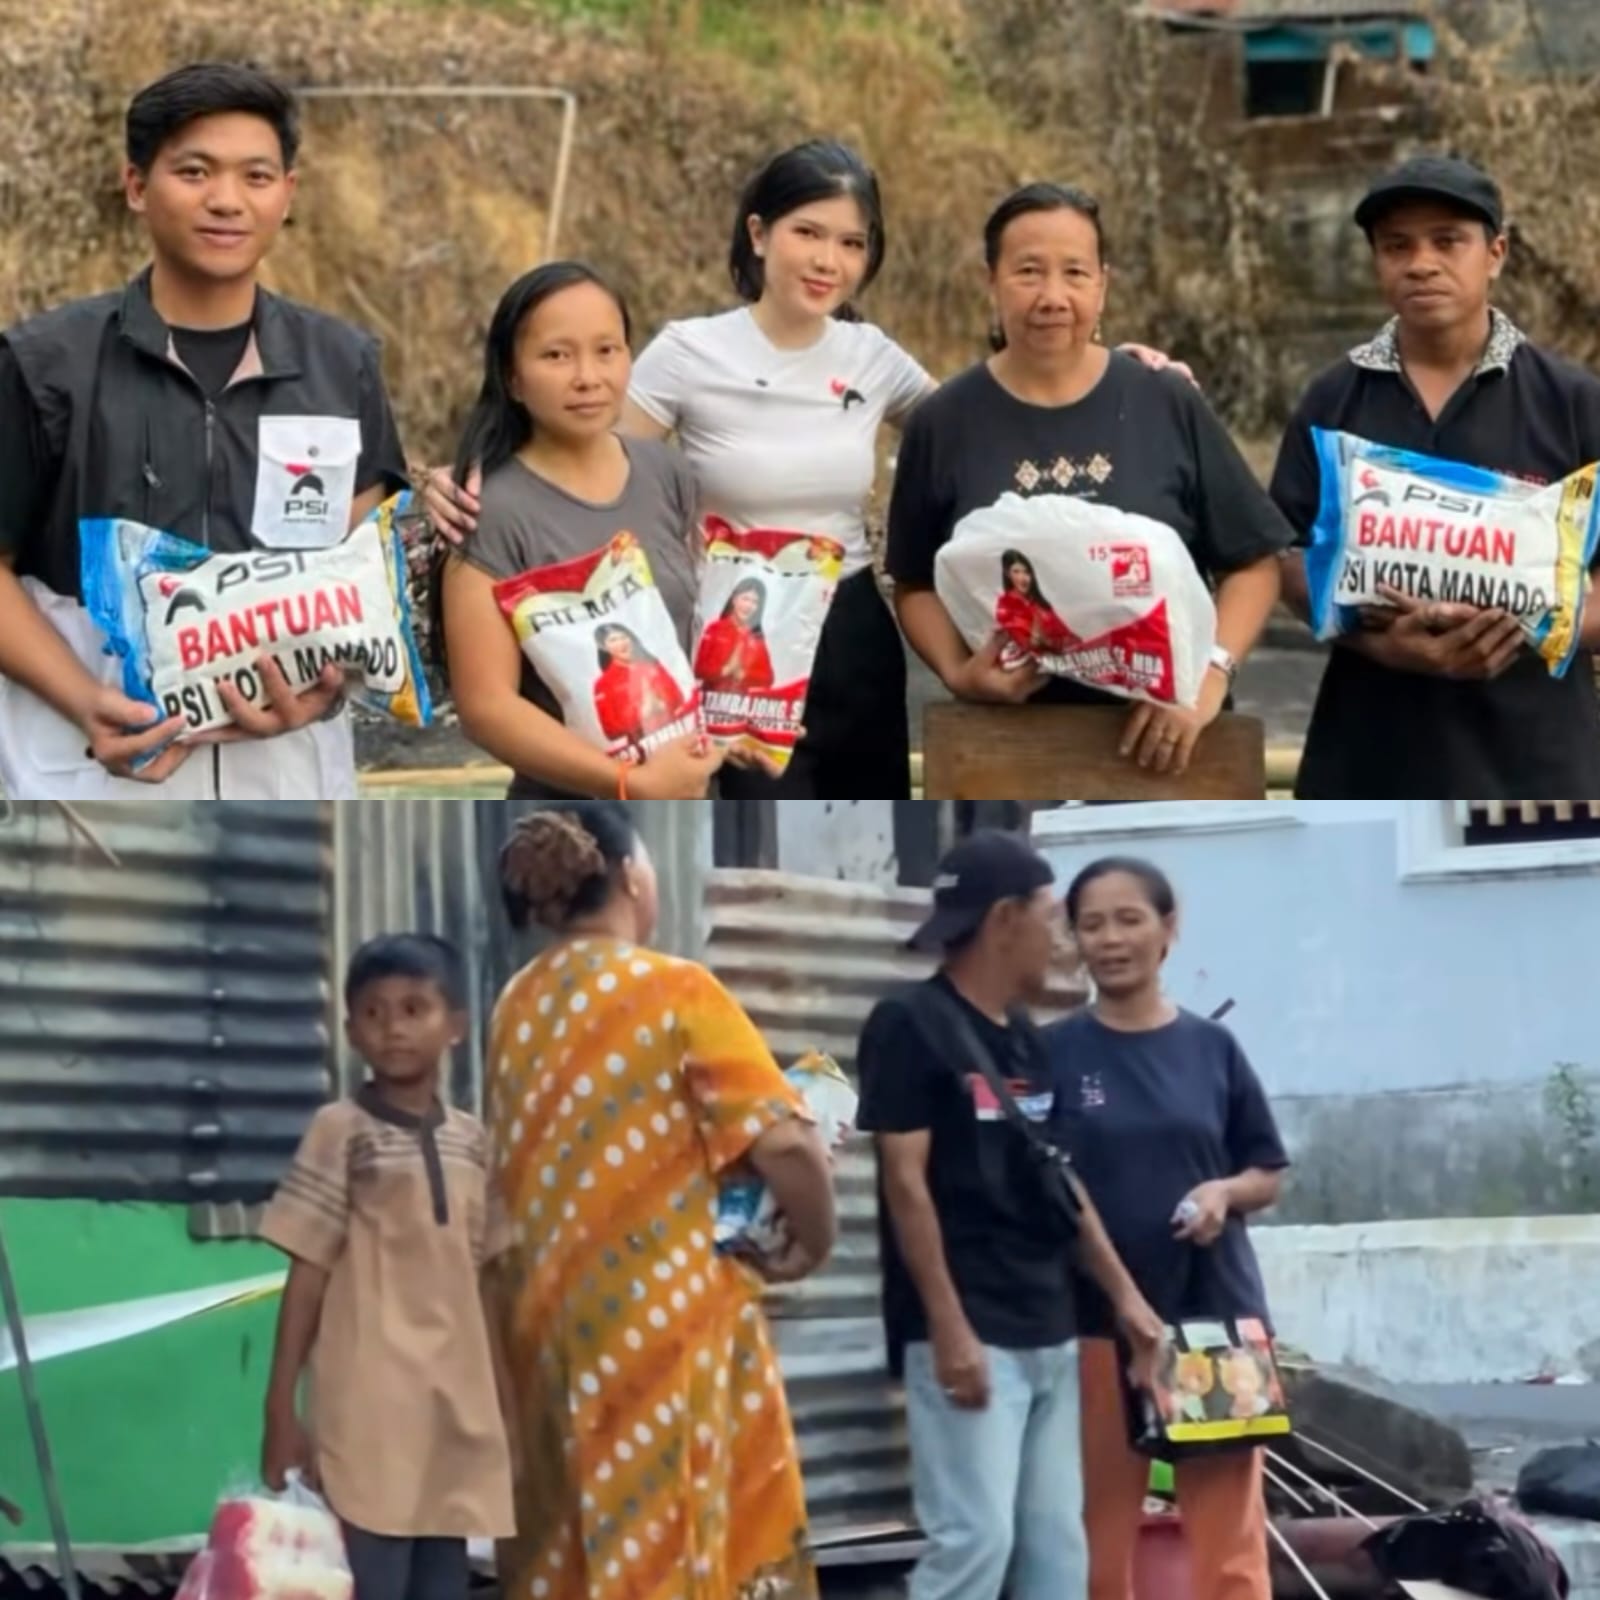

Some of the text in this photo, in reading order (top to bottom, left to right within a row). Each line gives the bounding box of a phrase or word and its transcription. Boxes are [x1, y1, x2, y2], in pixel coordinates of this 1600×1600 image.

[284, 499, 329, 516] PSI
[1403, 484, 1485, 516] PSI
[1358, 512, 1516, 567] BANTUAN
[215, 549, 306, 594] PSI
[1373, 560, 1434, 599] KOTA
[1439, 567, 1547, 617] MANADO
[177, 584, 364, 670] BANTUAN
[162, 683, 212, 728] PSI
